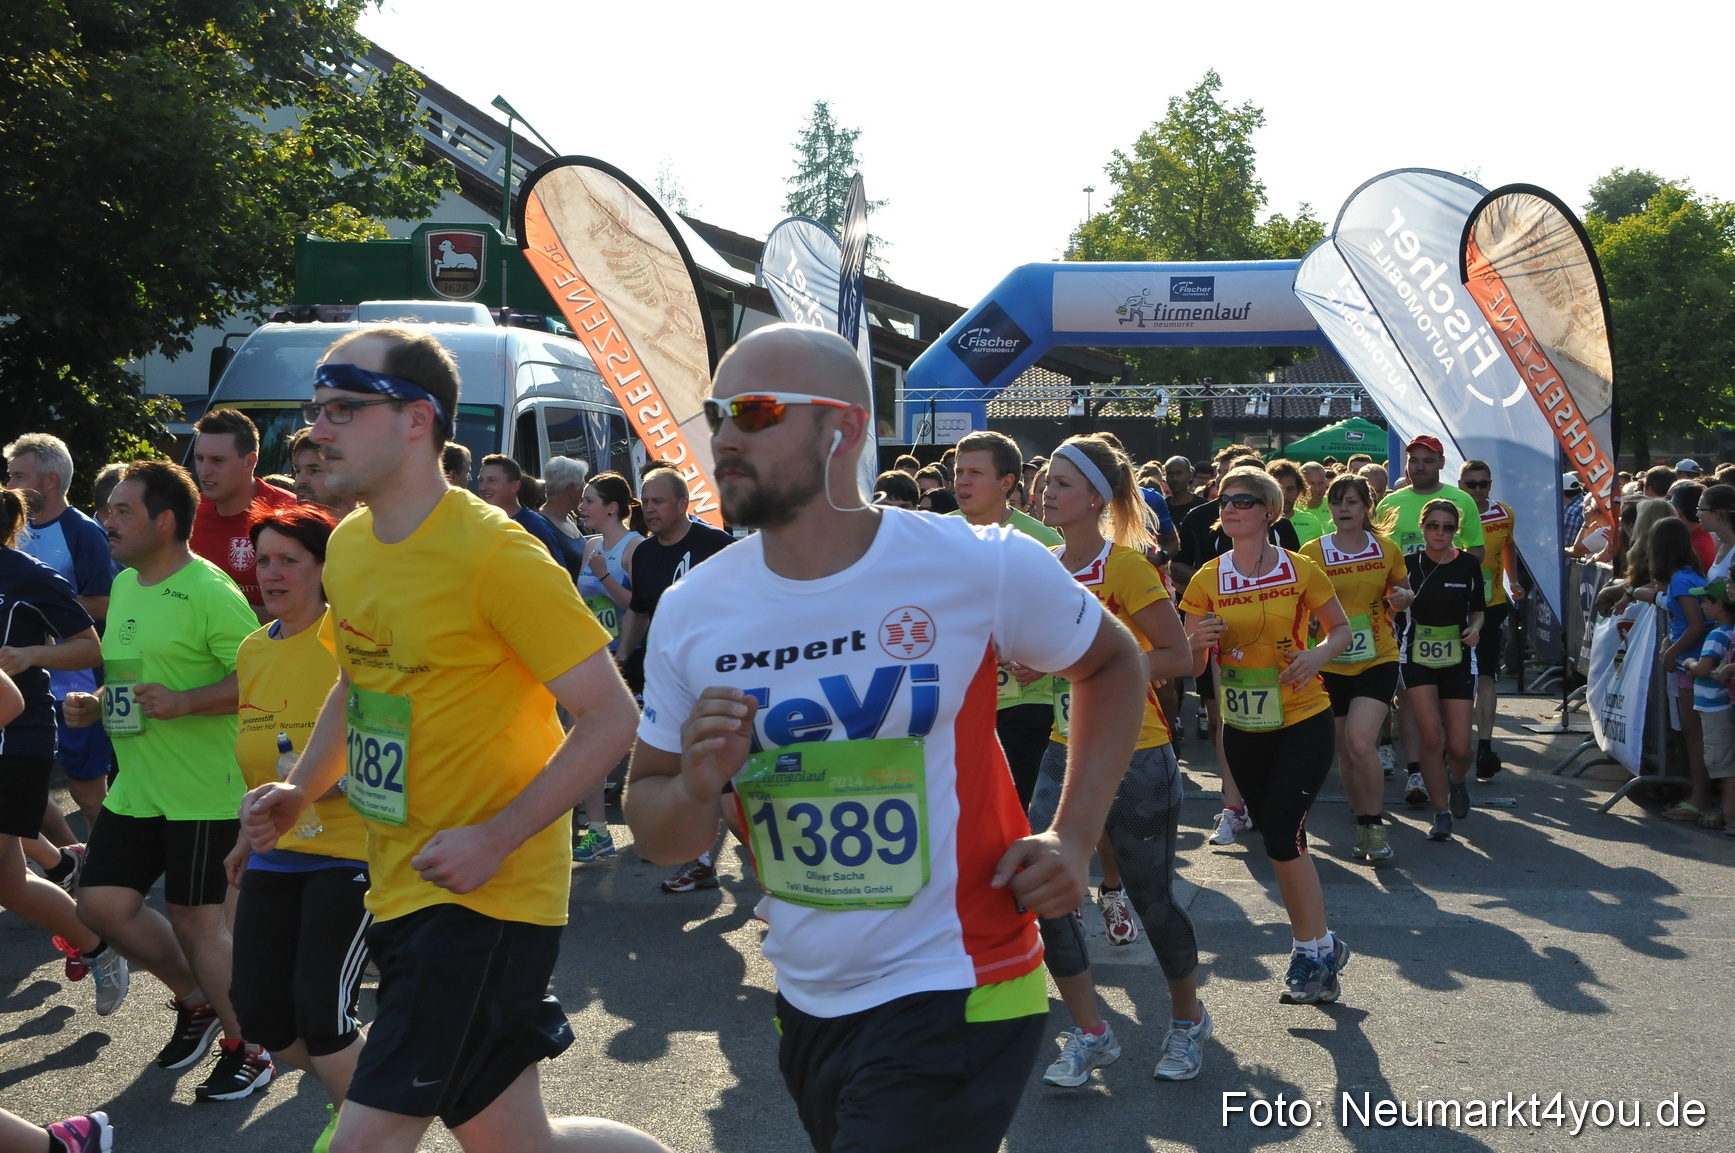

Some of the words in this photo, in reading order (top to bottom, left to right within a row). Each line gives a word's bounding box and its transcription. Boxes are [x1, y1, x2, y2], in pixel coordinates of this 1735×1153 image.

[444, 281, 468, 293] 1628
[1153, 302, 1252, 320] firmenlauf
[968, 336, 1020, 347] Fischer
[1485, 522, 1510, 533] BÖGL
[1326, 566, 1354, 577] MAX
[1357, 561, 1386, 572] BÖGL
[1218, 595, 1253, 608] MAX
[1258, 587, 1299, 601] BÖGL
[715, 629, 866, 673] expert
[1418, 640, 1453, 658] 961
[1225, 687, 1269, 715] 817
[246, 723, 263, 732] Tiroler
[265, 722, 276, 730] Hof
[280, 721, 316, 729] Neumarkt
[347, 728, 403, 793] 1282
[752, 798, 918, 868] 1389
[806, 870, 832, 882] Oliver
[833, 872, 865, 881] Sacha
[786, 881, 802, 891] TeVi
[803, 884, 823, 895] Markt
[825, 885, 862, 896] Handels
[864, 886, 893, 894] GmbH
